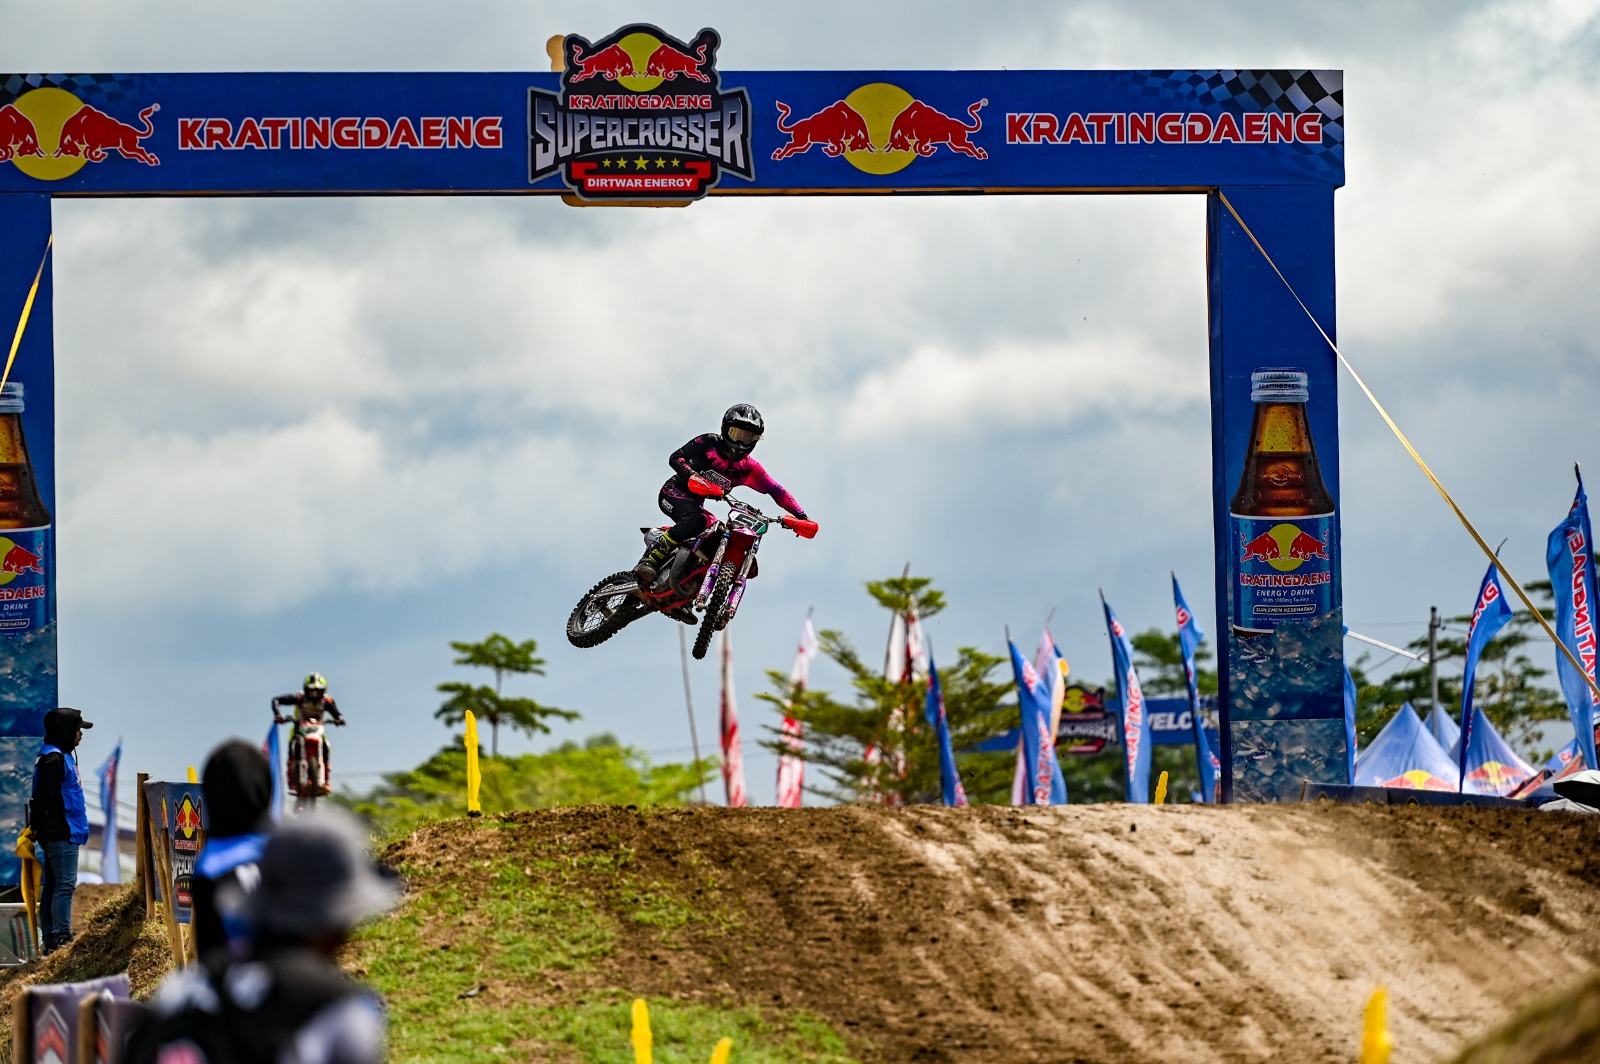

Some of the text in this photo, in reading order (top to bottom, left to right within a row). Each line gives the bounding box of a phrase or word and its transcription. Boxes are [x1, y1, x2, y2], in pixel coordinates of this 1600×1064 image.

[569, 94, 712, 110] KRATINGDAENG
[178, 116, 503, 150] KRATINGDAENG
[535, 97, 745, 171] SUPERCROSSER
[1006, 112, 1323, 144] KRATINGDAENG
[587, 178, 693, 188] DIRTWAR ENERGY
[1240, 571, 1331, 588] KRATINGDAENG
[1256, 588, 1315, 597] ENERGY DRINK
[3, 603, 29, 611] DRINK
